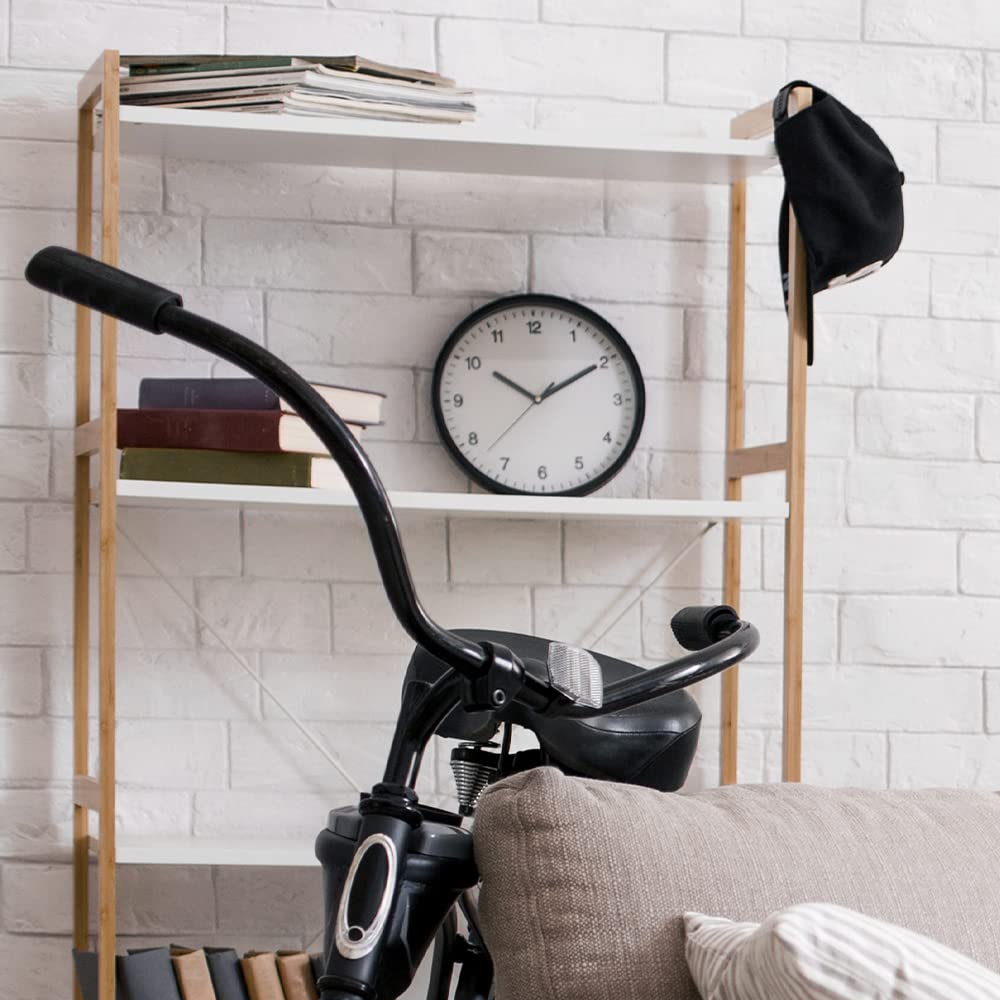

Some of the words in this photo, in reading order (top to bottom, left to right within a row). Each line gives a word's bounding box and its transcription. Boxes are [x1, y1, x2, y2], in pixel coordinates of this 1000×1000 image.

[526, 321, 541, 334] 12
[491, 330, 503, 343] 11
[570, 329, 576, 342] 1
[465, 356, 481, 370] 10
[600, 356, 609, 368] 2
[454, 394, 463, 407] 9
[613, 392, 623, 406] 3
[468, 432, 478, 445] 8
[603, 431, 612, 443] 4
[500, 457, 510, 471] 7
[575, 456, 583, 470] 5
[538, 466, 547, 479] 6
